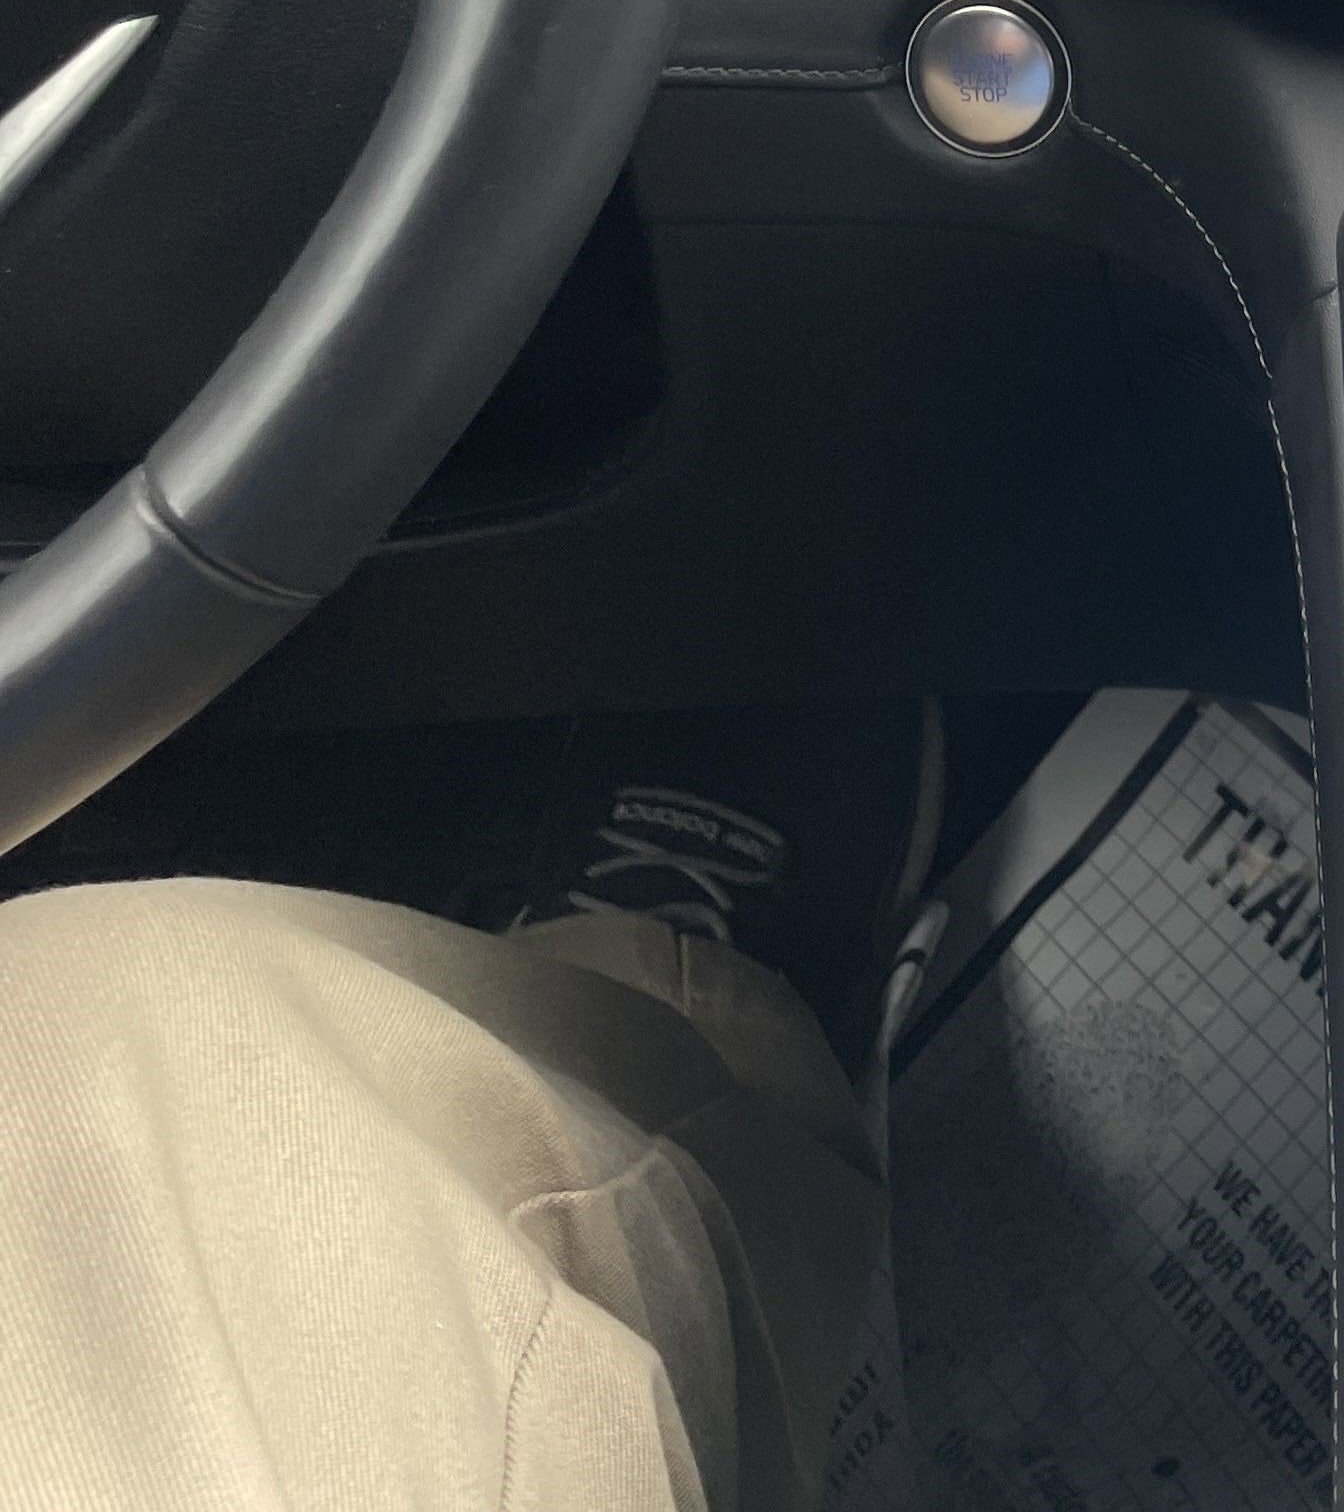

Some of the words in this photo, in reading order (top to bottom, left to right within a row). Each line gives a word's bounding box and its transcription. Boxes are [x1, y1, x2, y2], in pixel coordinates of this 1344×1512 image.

[960, 87, 1008, 103] STOP
[1177, 1195, 1245, 1283] YOUR
[1213, 1159, 1262, 1217] WE
[1250, 1203, 1315, 1281] HAVE
[1149, 1250, 1216, 1332] WITH
[1206, 1317, 1264, 1396] THIS
